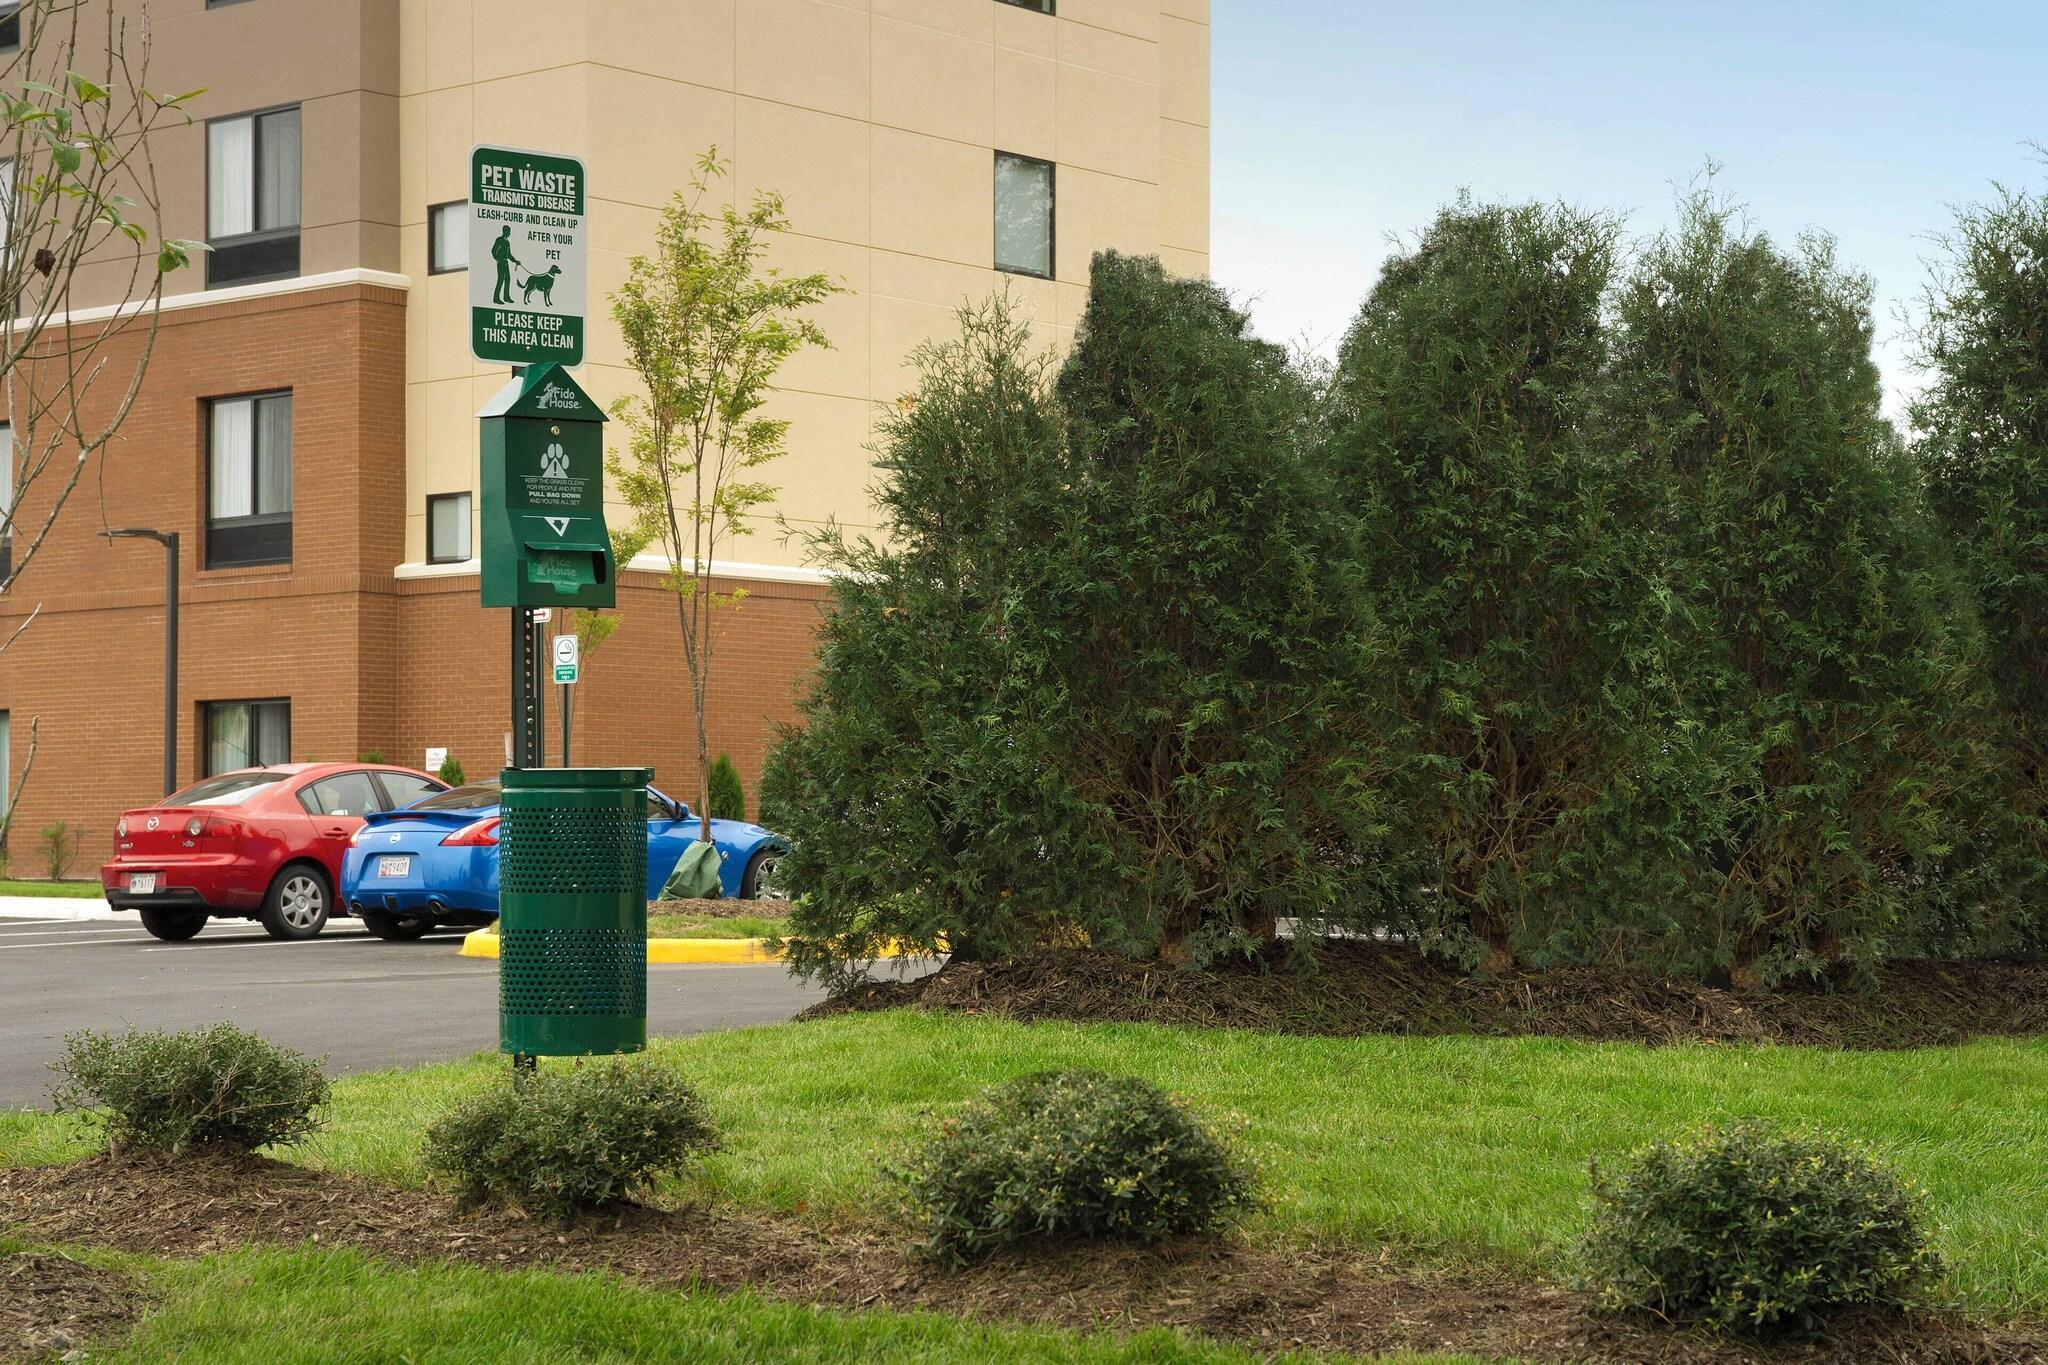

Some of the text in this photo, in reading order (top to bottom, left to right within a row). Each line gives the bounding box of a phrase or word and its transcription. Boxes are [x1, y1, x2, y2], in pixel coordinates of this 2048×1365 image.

[481, 164, 575, 195] PET WASTE
[482, 189, 575, 211] TRANSMITS DISEASE
[477, 208, 578, 229] LEASH-CURB AND CLEAN UP
[527, 231, 573, 245] AFTER YOUR
[545, 249, 561, 260] PET
[495, 312, 563, 331] PLEASE KEEP
[483, 328, 574, 349] THIS AREA CLEAN
[555, 387, 575, 400] Fido
[549, 399, 580, 409] House
